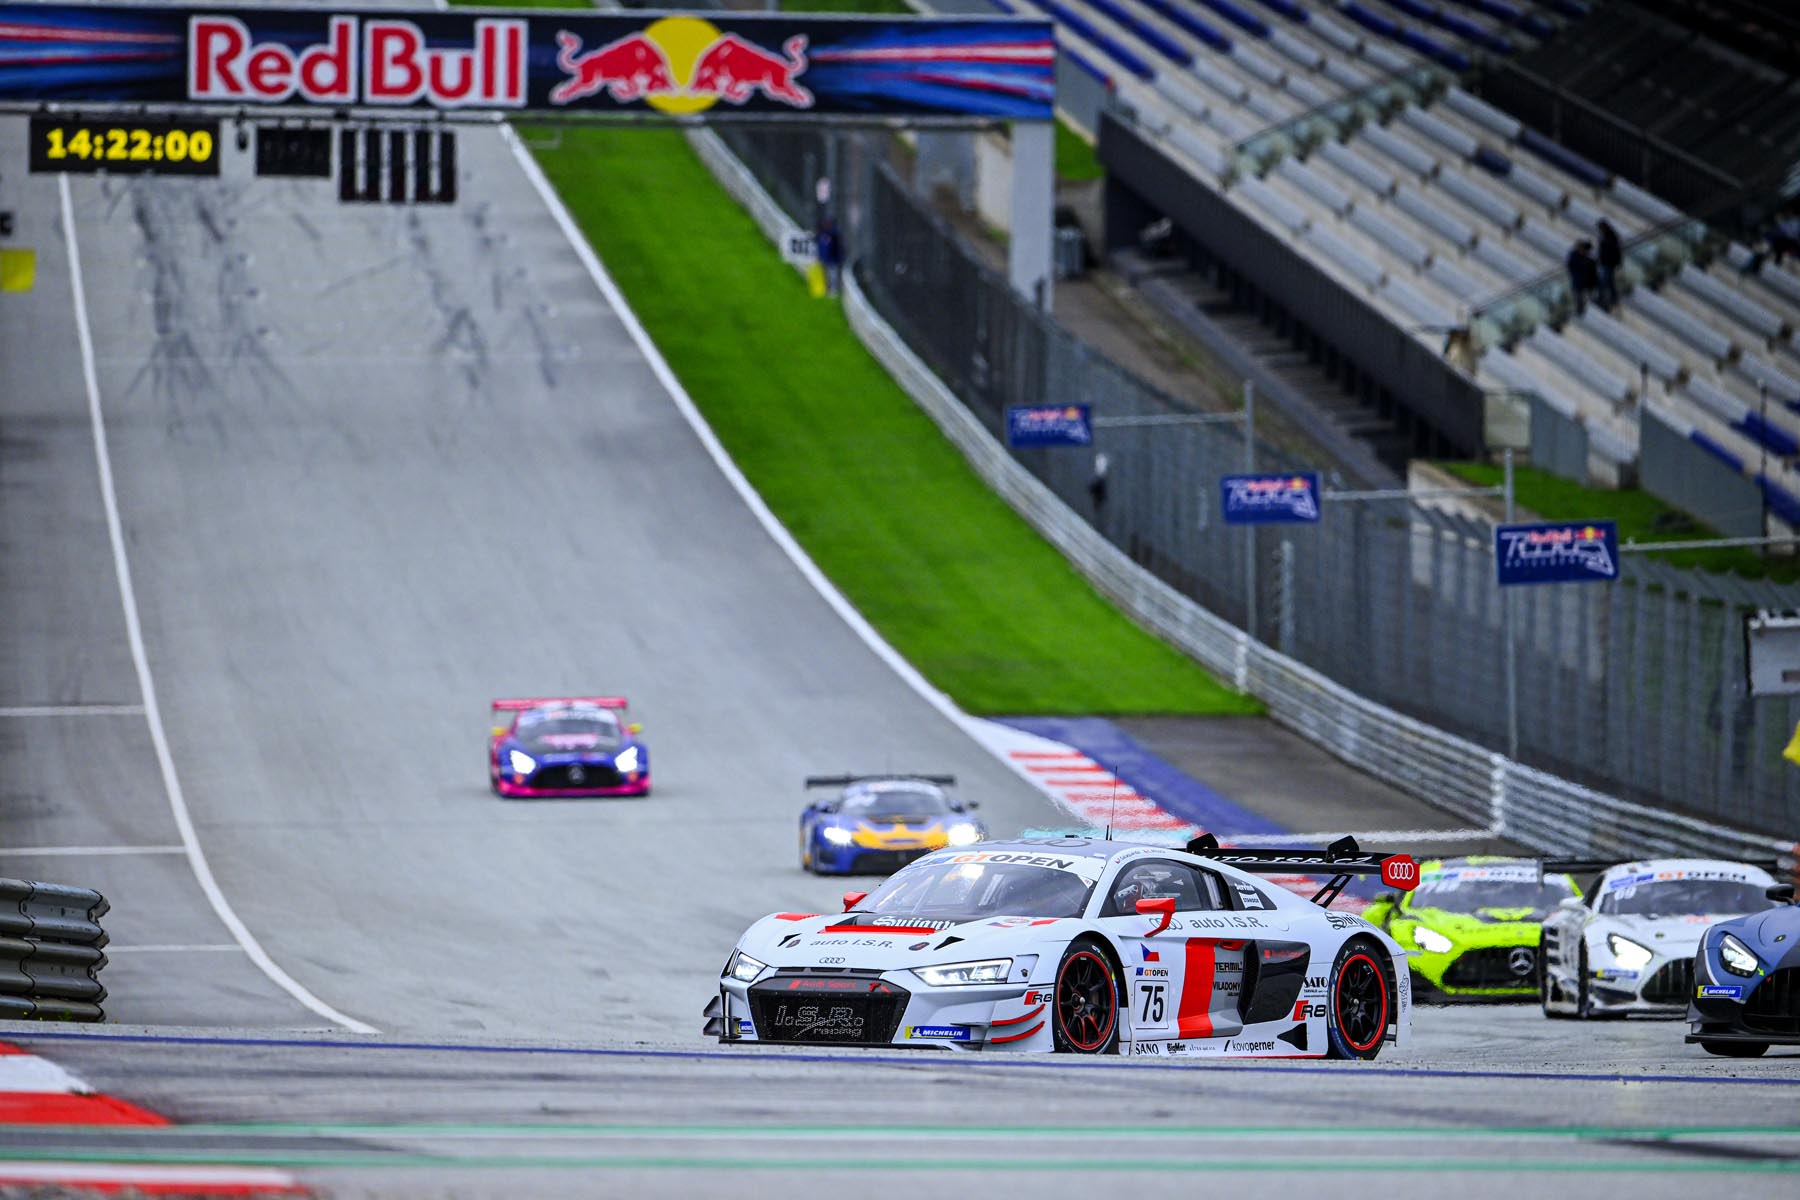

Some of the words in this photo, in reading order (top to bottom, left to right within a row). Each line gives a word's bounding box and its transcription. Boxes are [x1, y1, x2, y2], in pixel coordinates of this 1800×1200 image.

[191, 18, 355, 99] Red
[366, 22, 525, 103] Bull
[46, 127, 214, 162] 14:22:00
[1189, 917, 1225, 929] auto
[1223, 916, 1269, 929] I.S.R.
[809, 939, 849, 947] auto
[851, 939, 893, 949] I.S.R.
[1140, 985, 1165, 1023] 75
[1300, 1004, 1327, 1018] R8
[1232, 1040, 1275, 1051] kovoperner
